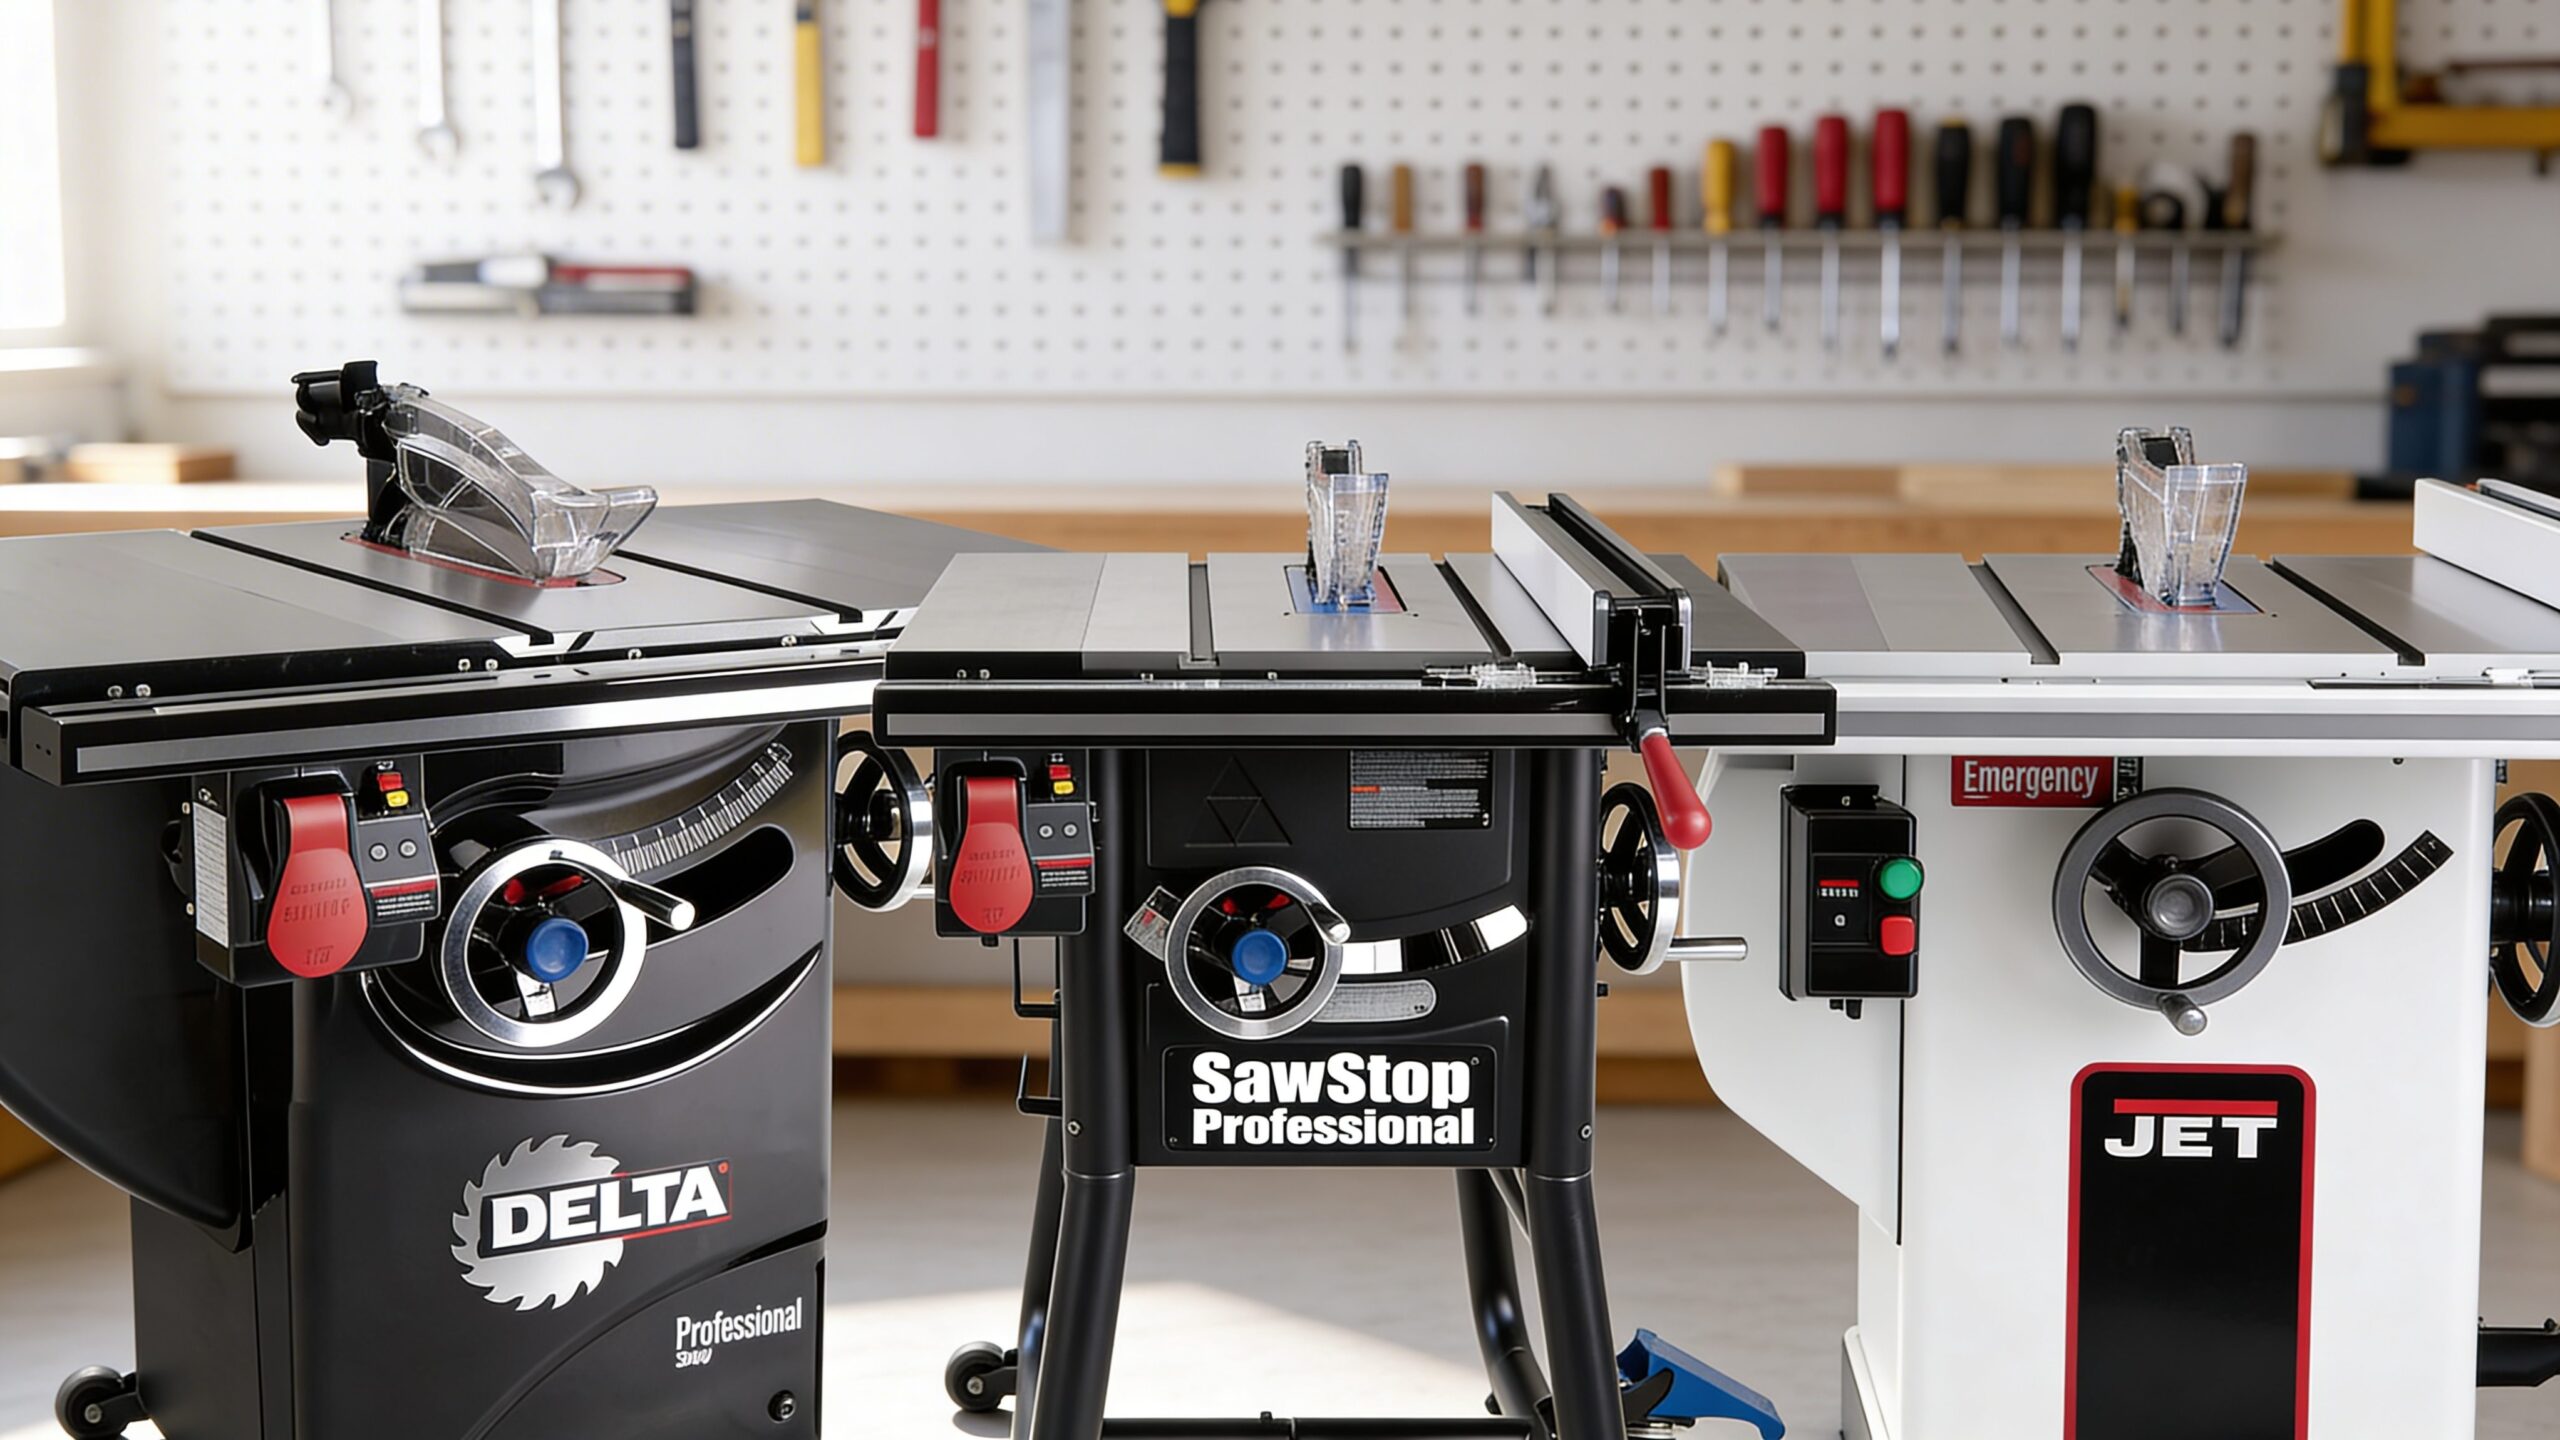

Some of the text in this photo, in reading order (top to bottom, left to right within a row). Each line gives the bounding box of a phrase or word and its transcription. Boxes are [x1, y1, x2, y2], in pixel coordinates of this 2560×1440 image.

[1963, 760, 2099, 799] Emergency
[1191, 1051, 1471, 1110] SawStop
[1192, 1107, 1475, 1145] Professional
[2104, 1115, 2278, 1158] JET
[492, 1165, 728, 1249] DELTA
[676, 1296, 803, 1351] Professional
